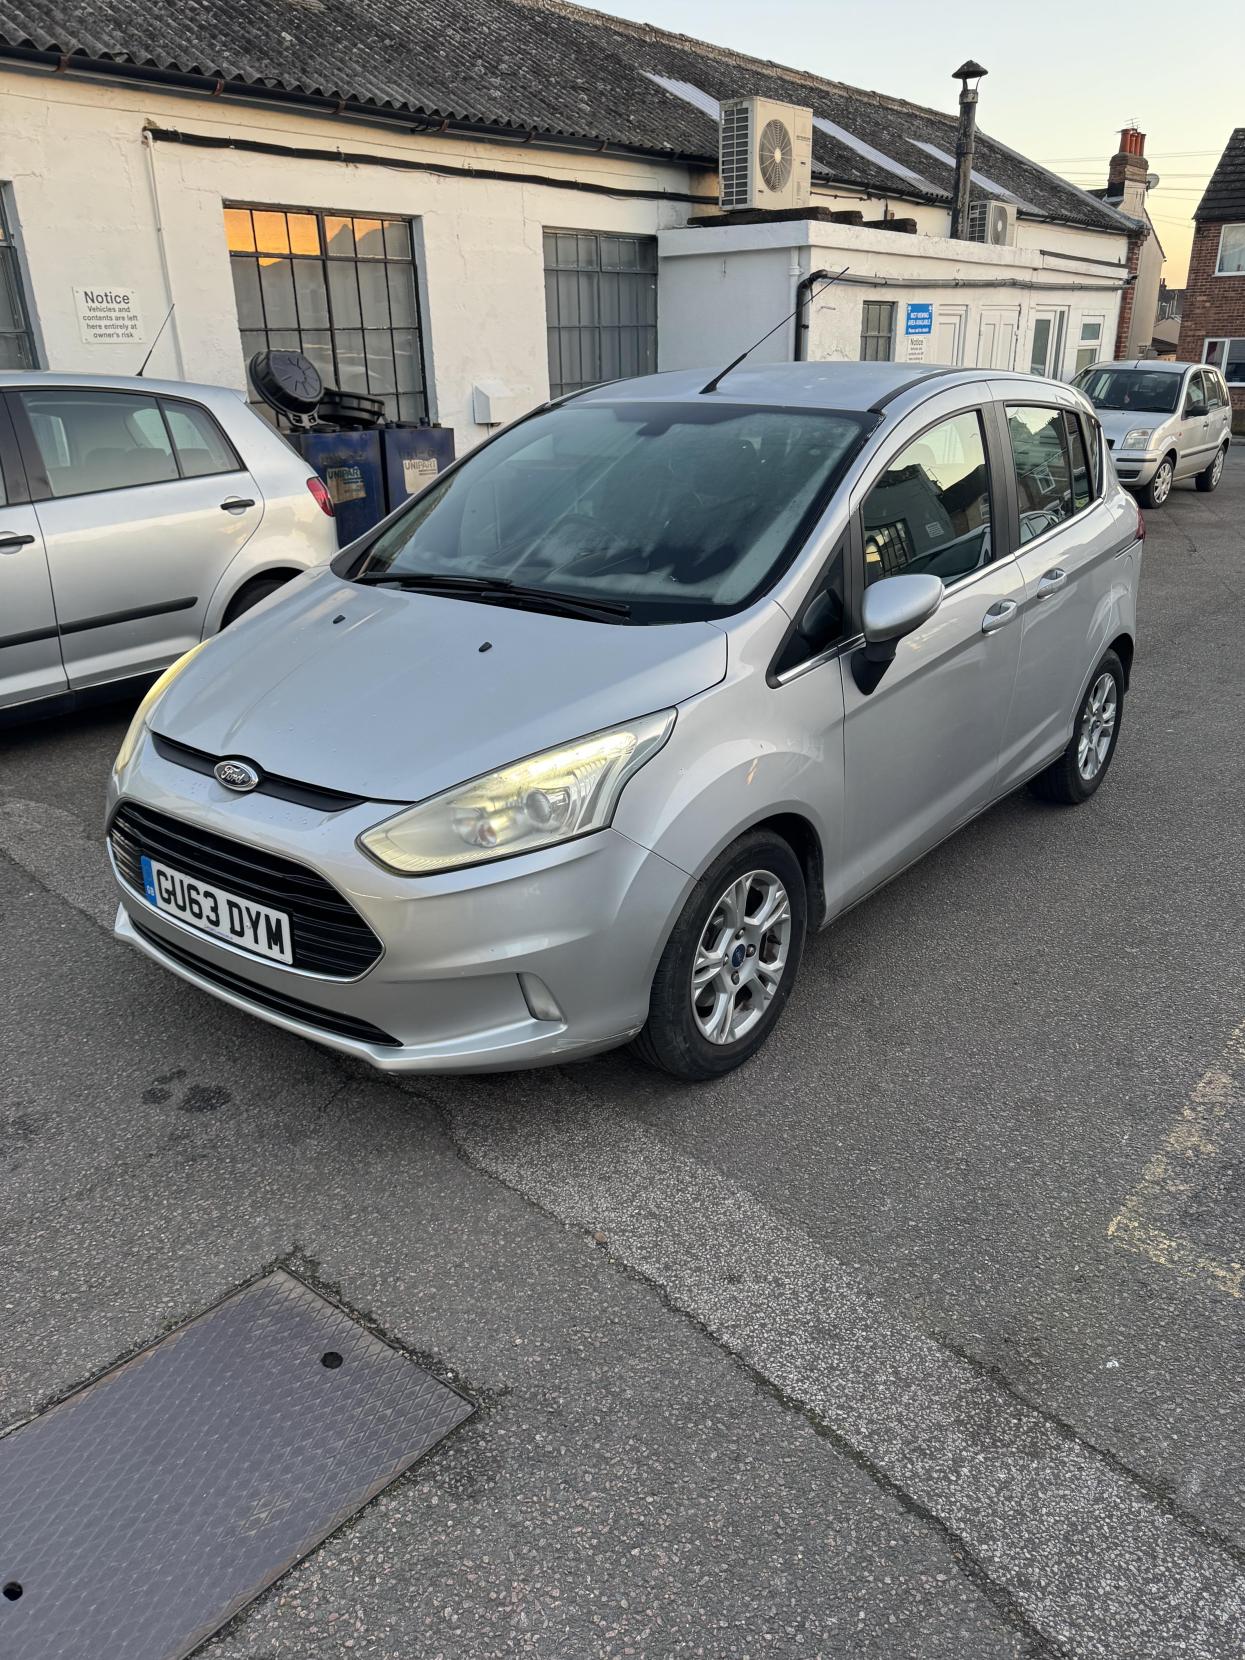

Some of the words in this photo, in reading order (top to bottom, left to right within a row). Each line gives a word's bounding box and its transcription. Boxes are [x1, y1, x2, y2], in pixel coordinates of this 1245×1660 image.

[84, 291, 129, 304] Notice
[104, 323, 129, 331] entirely
[404, 460, 436, 470] UNIPART
[328, 468, 361, 480] UNIPAR
[221, 765, 246, 784] Ford
[156, 869, 220, 928] GU63
[226, 899, 285, 955] DYM
